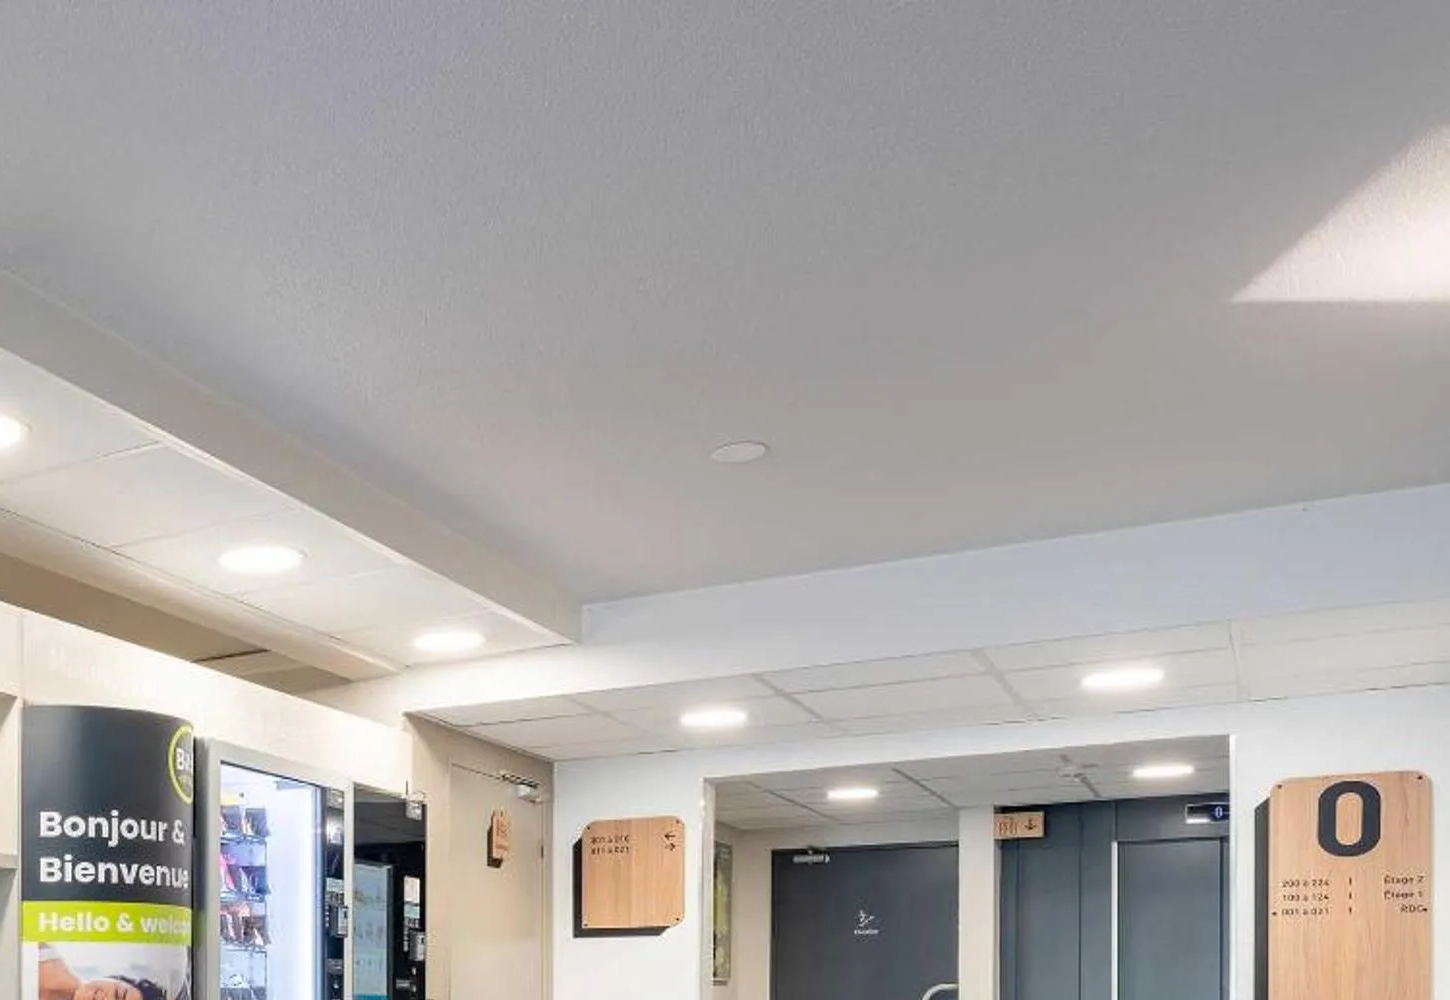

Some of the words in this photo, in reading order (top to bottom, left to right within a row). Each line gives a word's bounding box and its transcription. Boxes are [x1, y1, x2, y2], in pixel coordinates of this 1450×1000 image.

[39, 810, 168, 848] Bonjour
[172, 819, 186, 845] &
[38, 911, 110, 933] Hello
[116, 913, 134, 933] &
